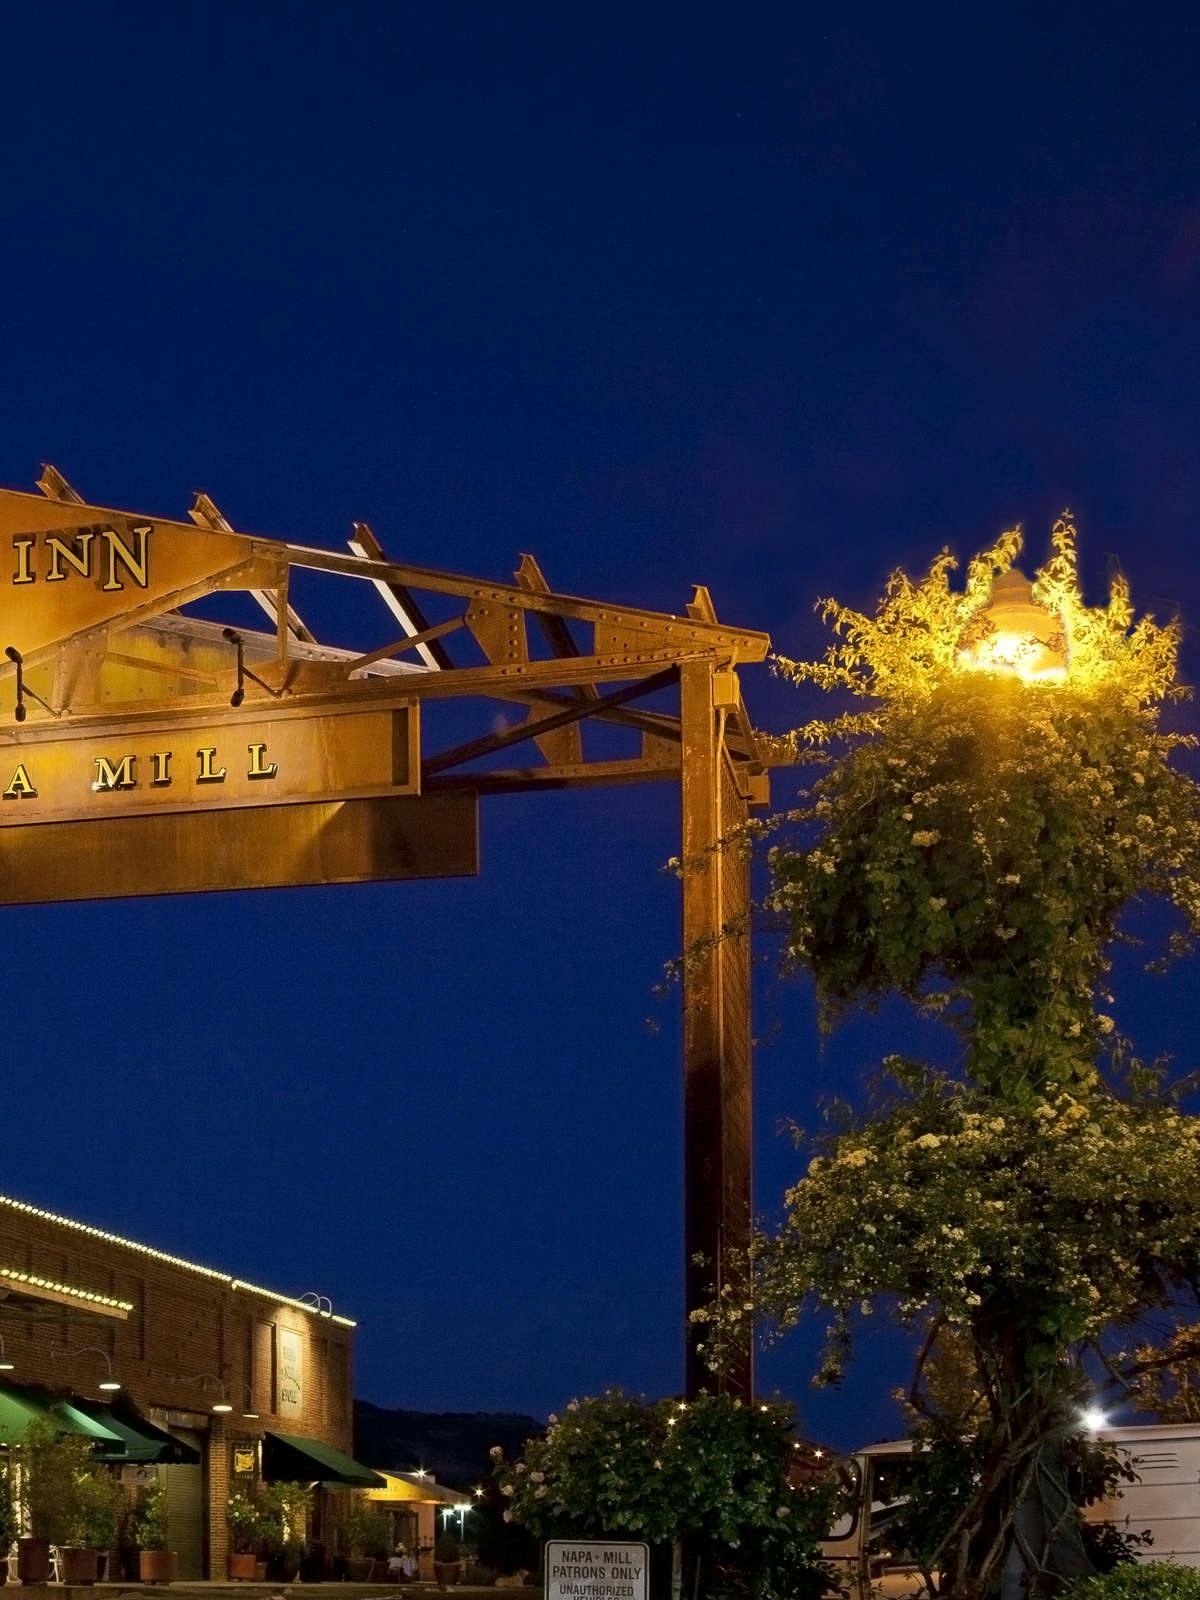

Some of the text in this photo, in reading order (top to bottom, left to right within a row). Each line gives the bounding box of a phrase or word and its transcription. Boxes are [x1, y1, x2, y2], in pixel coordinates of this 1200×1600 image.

[12, 525, 153, 592] INN
[92, 743, 278, 793] MILL
[561, 1550, 633, 1565] NAPA MILL
[552, 1565, 641, 1580] PATRONS ONLY
[560, 1584, 634, 1596] UNAUTHORIZED
